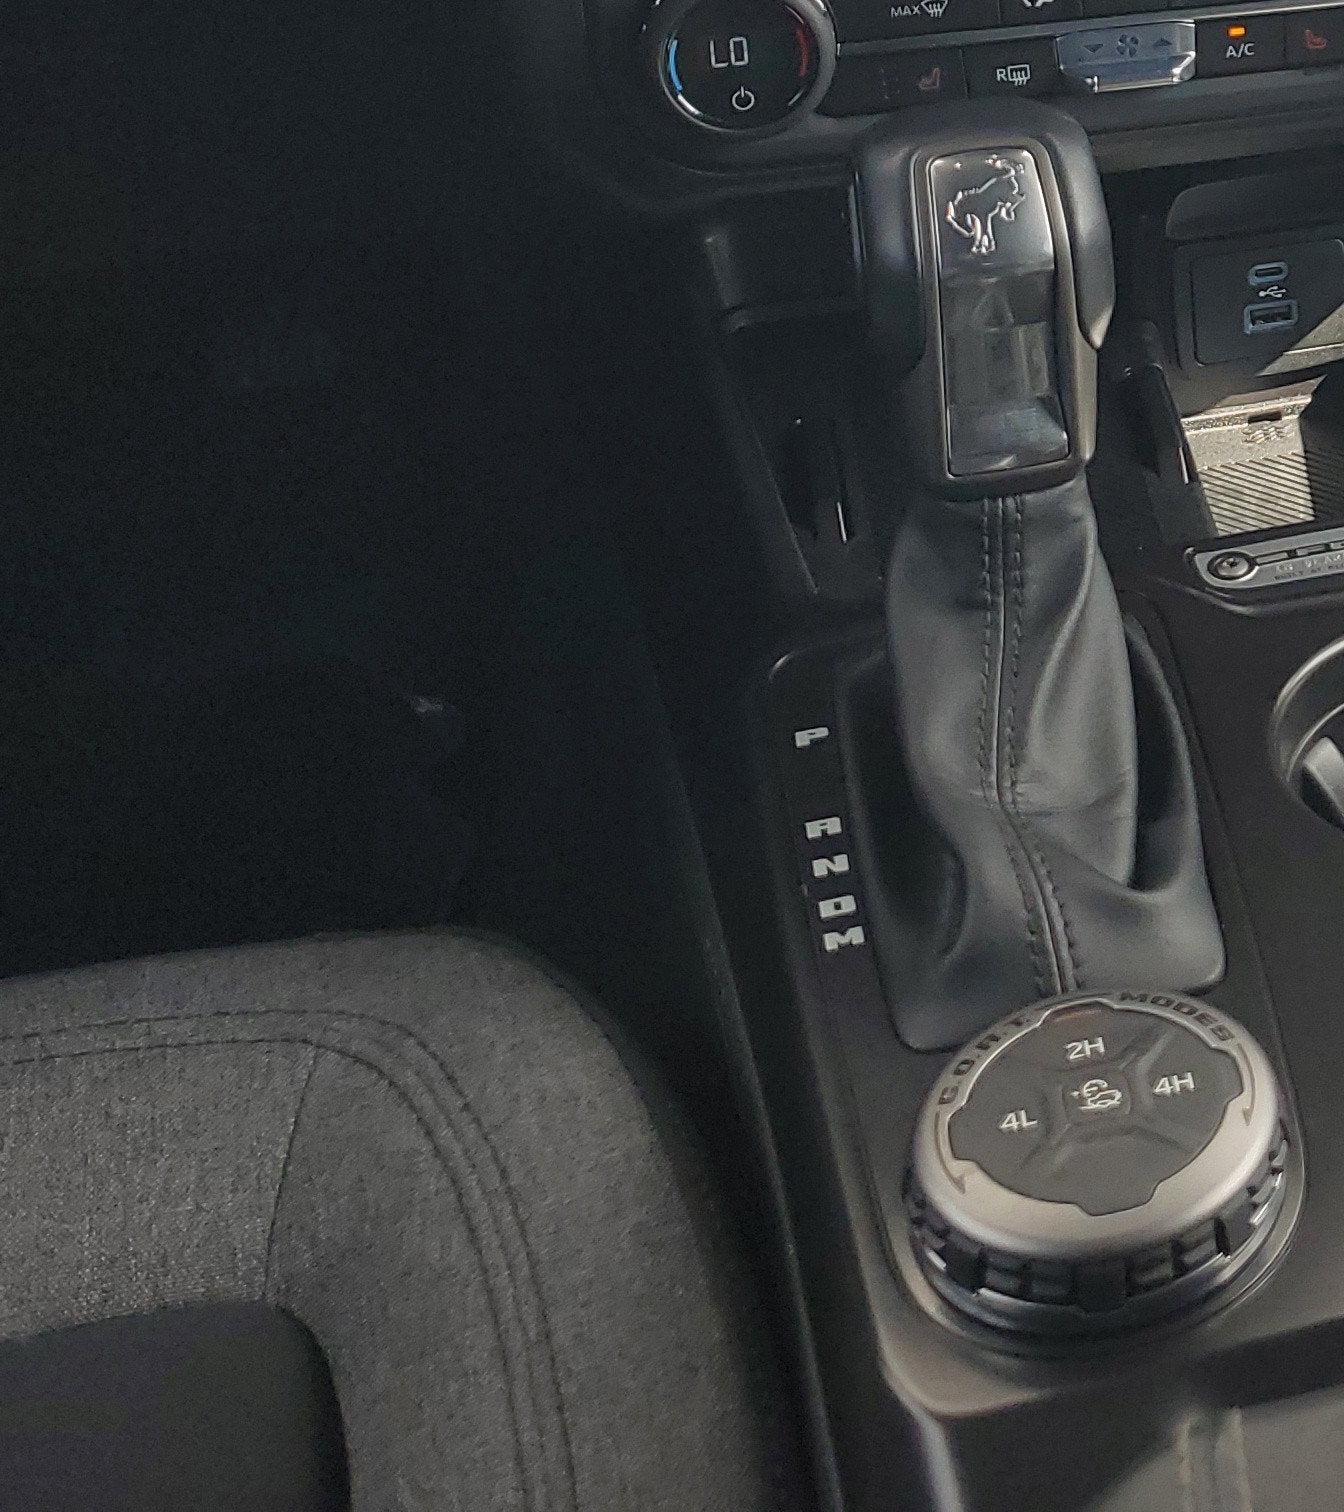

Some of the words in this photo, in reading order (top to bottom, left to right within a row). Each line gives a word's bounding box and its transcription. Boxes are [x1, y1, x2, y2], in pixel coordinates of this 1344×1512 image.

[891, 5, 921, 17] MAX
[710, 37, 749, 68] LO
[1226, 43, 1254, 58] A/C
[796, 727, 829, 748] P
[811, 854, 849, 876] N
[823, 926, 864, 952] M
[1119, 991, 1236, 1042] MODES
[1066, 1036, 1106, 1061] 2H
[1154, 1072, 1196, 1096] 4H
[1000, 1109, 1038, 1131] 4L
